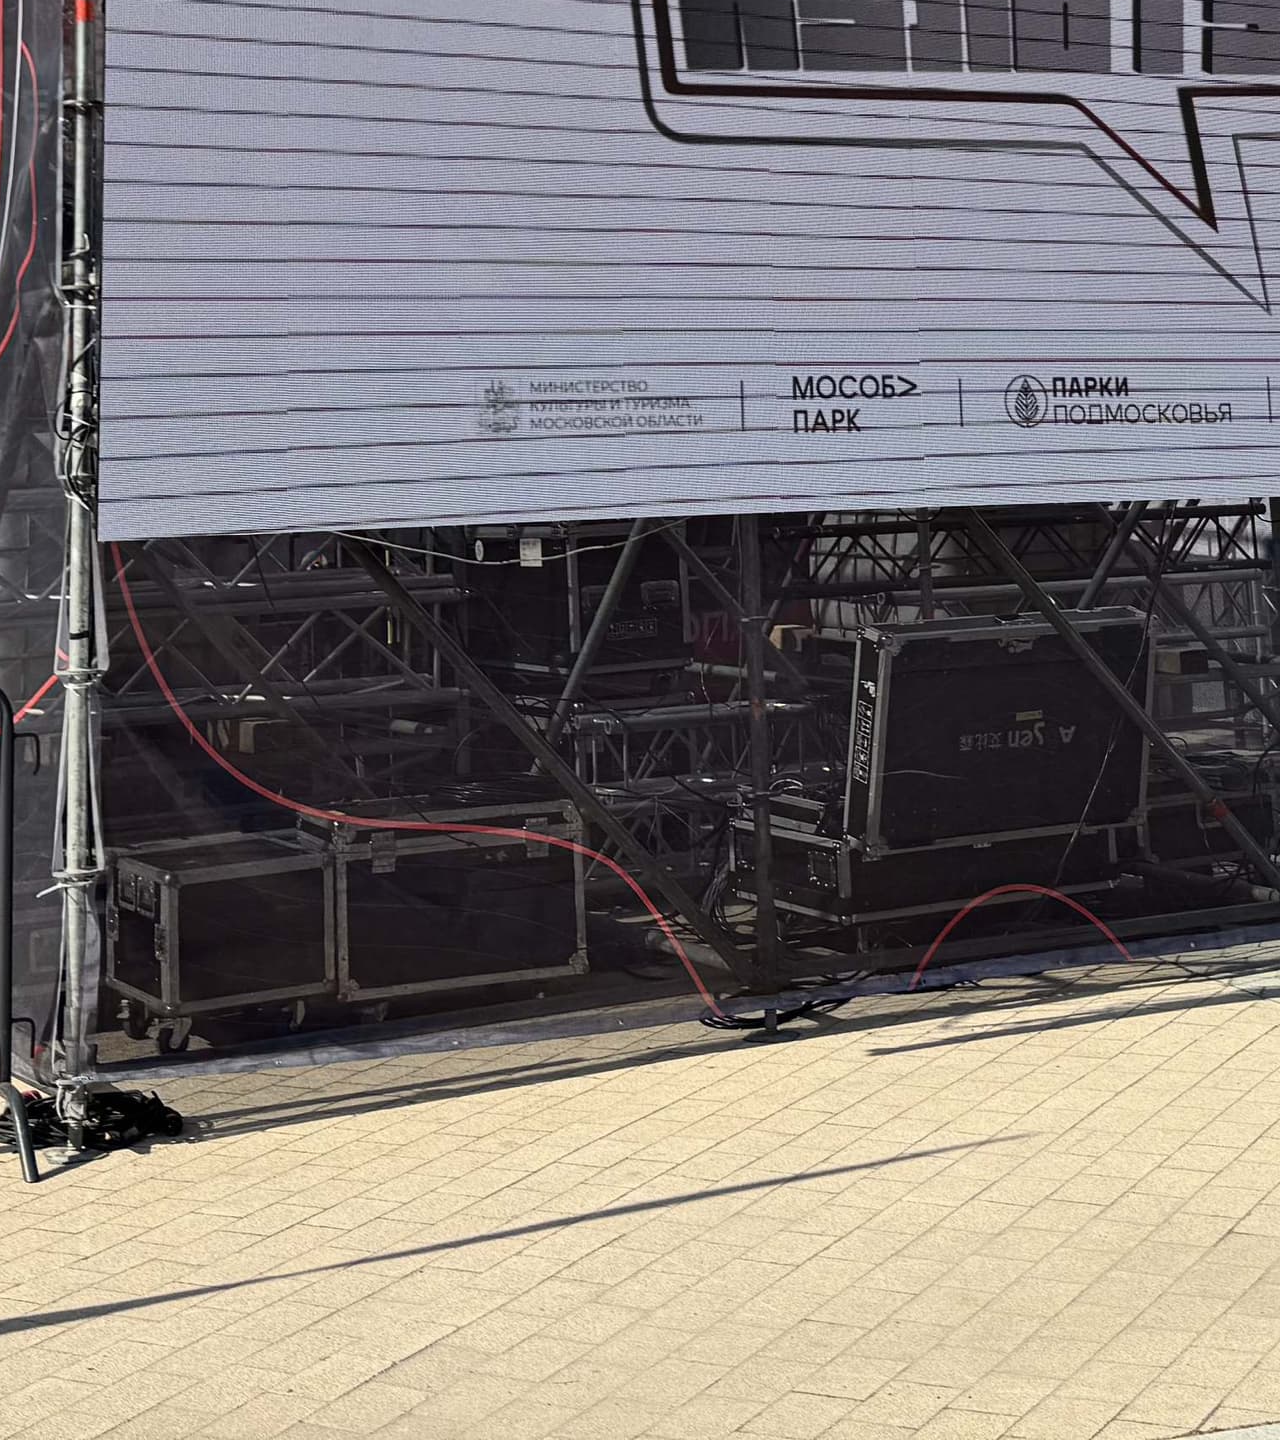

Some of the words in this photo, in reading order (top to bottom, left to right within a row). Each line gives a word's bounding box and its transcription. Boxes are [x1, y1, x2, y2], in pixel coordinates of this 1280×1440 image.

[529, 380, 648, 393] МИНИСТЕРСТВО
[1052, 376, 1129, 398] ПАРКИ
[529, 415, 634, 430] МОСКОВСКОЙ
[636, 413, 704, 427] ОБЛАСТИ
[792, 409, 862, 434] ПАРК
[1052, 401, 1232, 425] ПОДМОСКОВЬЯ
